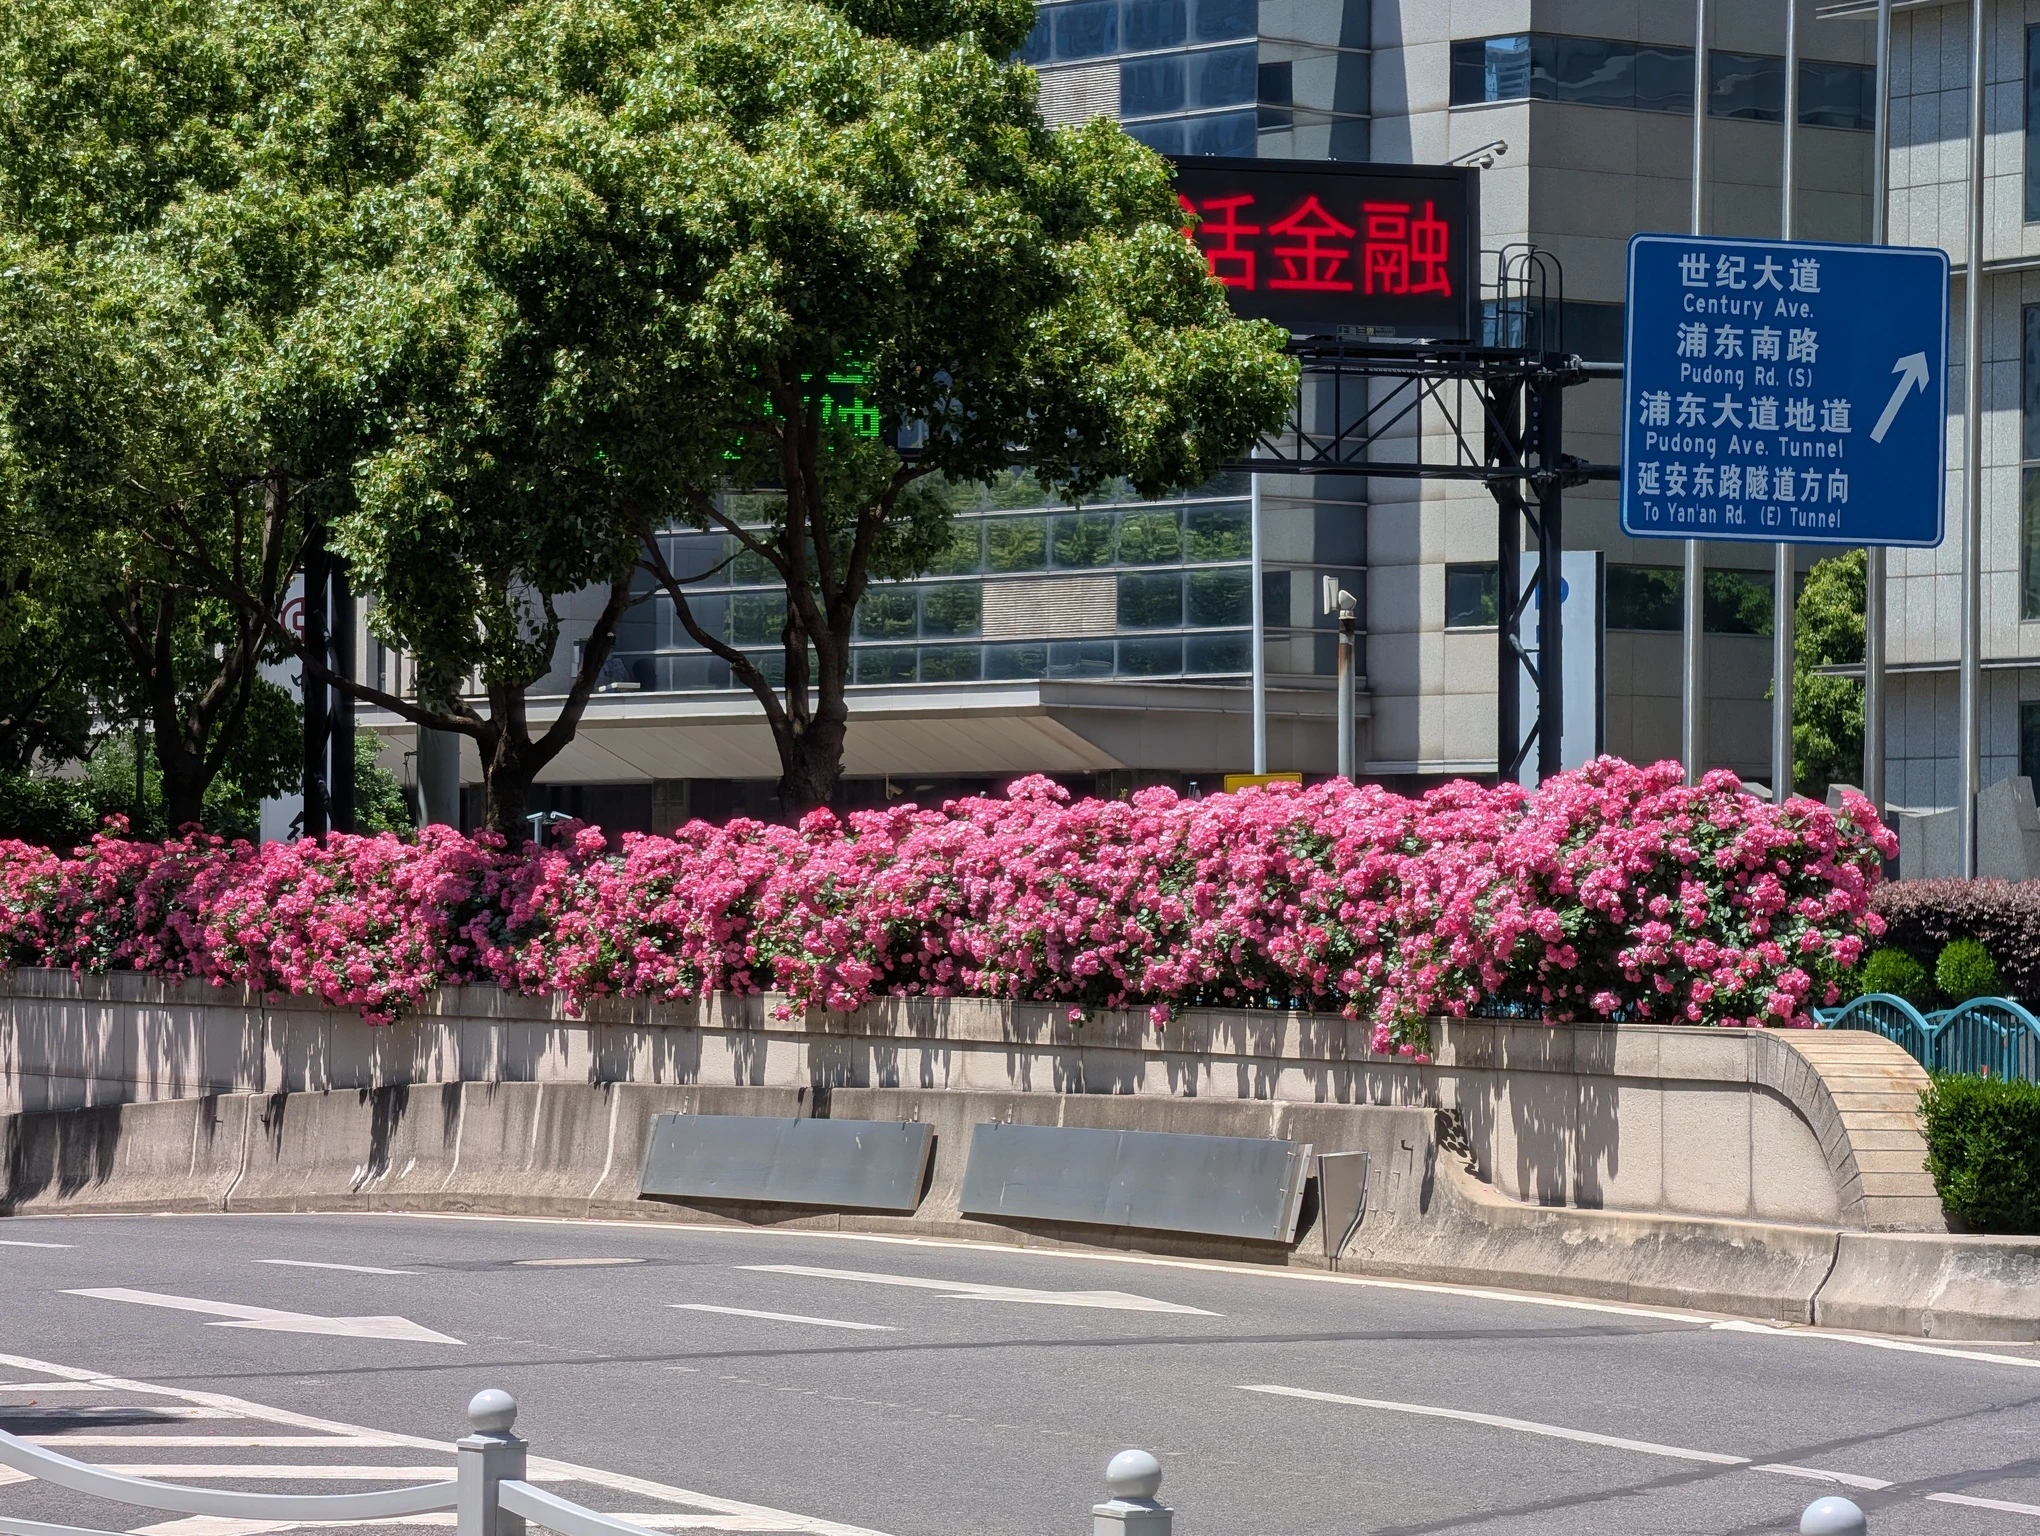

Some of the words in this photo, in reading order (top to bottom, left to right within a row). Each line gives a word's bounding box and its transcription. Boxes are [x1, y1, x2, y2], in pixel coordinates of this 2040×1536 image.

[1179, 194, 1453, 298] 活金融
[1678, 253, 1821, 293] 世纪大道
[1683, 293, 1763, 320] Century
[1774, 298, 1814, 318] Ave.
[1339, 326, 1375, 336] 上海三
[1676, 322, 1819, 363] 浦东南路
[1680, 363, 1744, 390] Pudong
[1755, 366, 1779, 386] Rd.
[1788, 368, 1813, 388] (S)
[1639, 391, 1852, 433] 浦东大道地道
[1646, 431, 1717, 459] Pudong
[1728, 435, 1769, 456] Ave.
[1779, 437, 1844, 458] Tunnel
[1637, 461, 1849, 504] 延安东路隧道方向
[1643, 502, 1660, 522] To
[1667, 502, 1717, 524] Yan'an
[1725, 504, 1746, 525] Rd.
[1760, 506, 1781, 527] (E)
[1790, 507, 1841, 529] Tunnel
